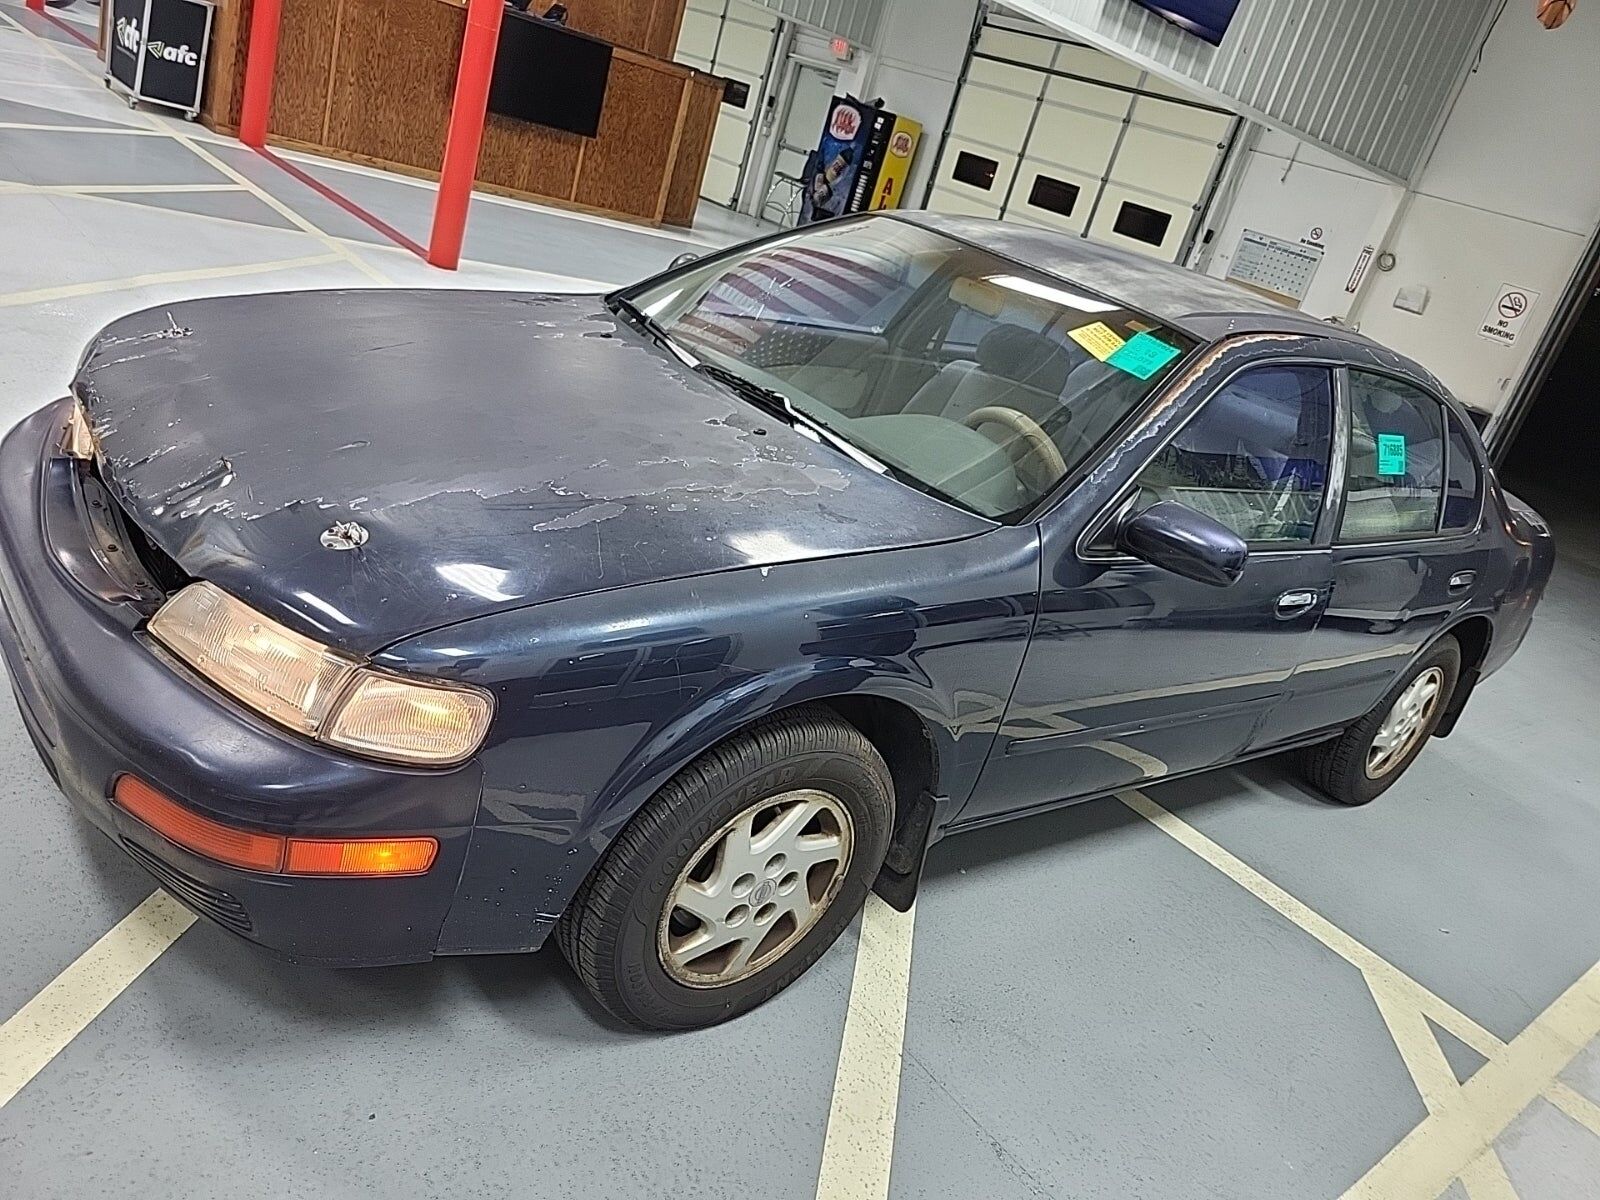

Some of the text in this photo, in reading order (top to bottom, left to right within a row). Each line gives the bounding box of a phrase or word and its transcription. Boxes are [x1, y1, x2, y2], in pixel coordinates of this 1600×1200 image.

[163, 44, 198, 66] afc
[1497, 319, 1509, 328] NO
[1482, 325, 1516, 341] SMOKING
